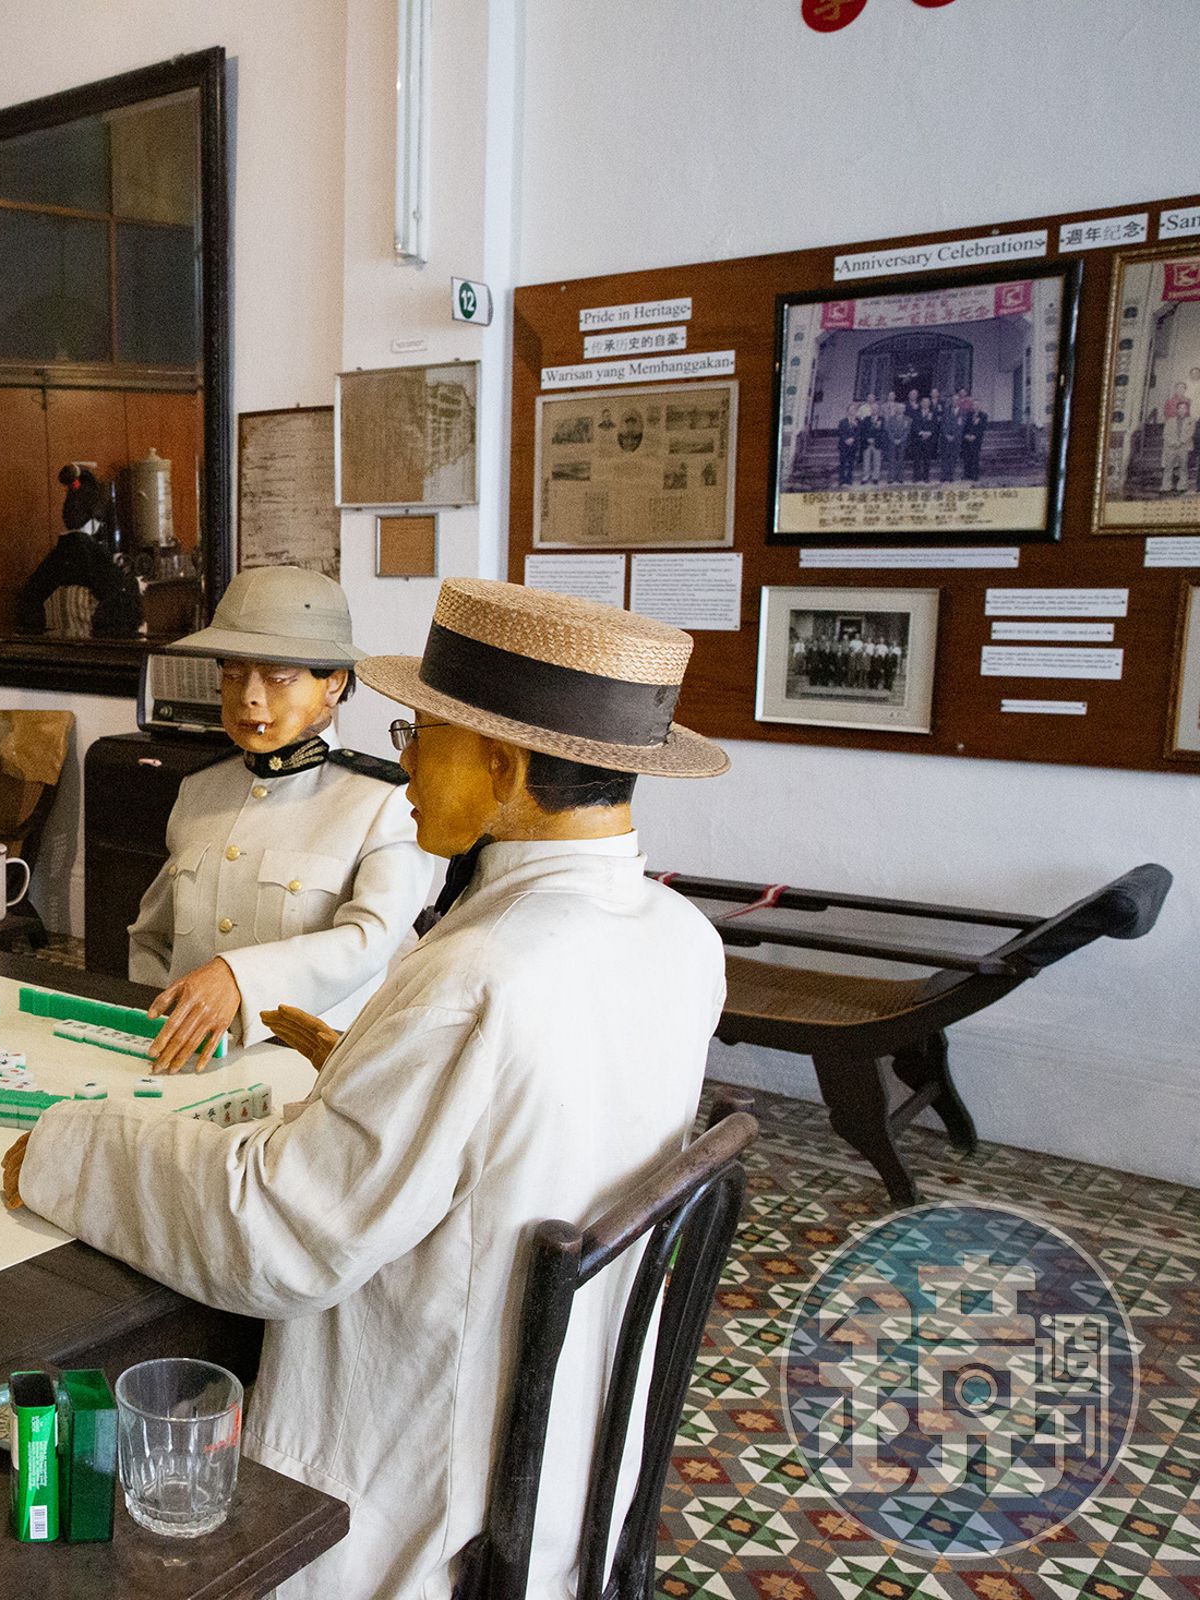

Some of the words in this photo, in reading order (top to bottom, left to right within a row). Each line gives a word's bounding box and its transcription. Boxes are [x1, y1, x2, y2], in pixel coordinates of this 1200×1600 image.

[839, 252, 933, 273] Anniversary
[937, 237, 1042, 262] Celebrations
[460, 290, 475, 311] 12
[584, 310, 614, 325] Pride
[619, 308, 630, 321] in
[634, 304, 686, 319] Heritage
[544, 368, 593, 383] Warisan
[596, 368, 625, 384] yang
[629, 356, 730, 375] Membanggakan
